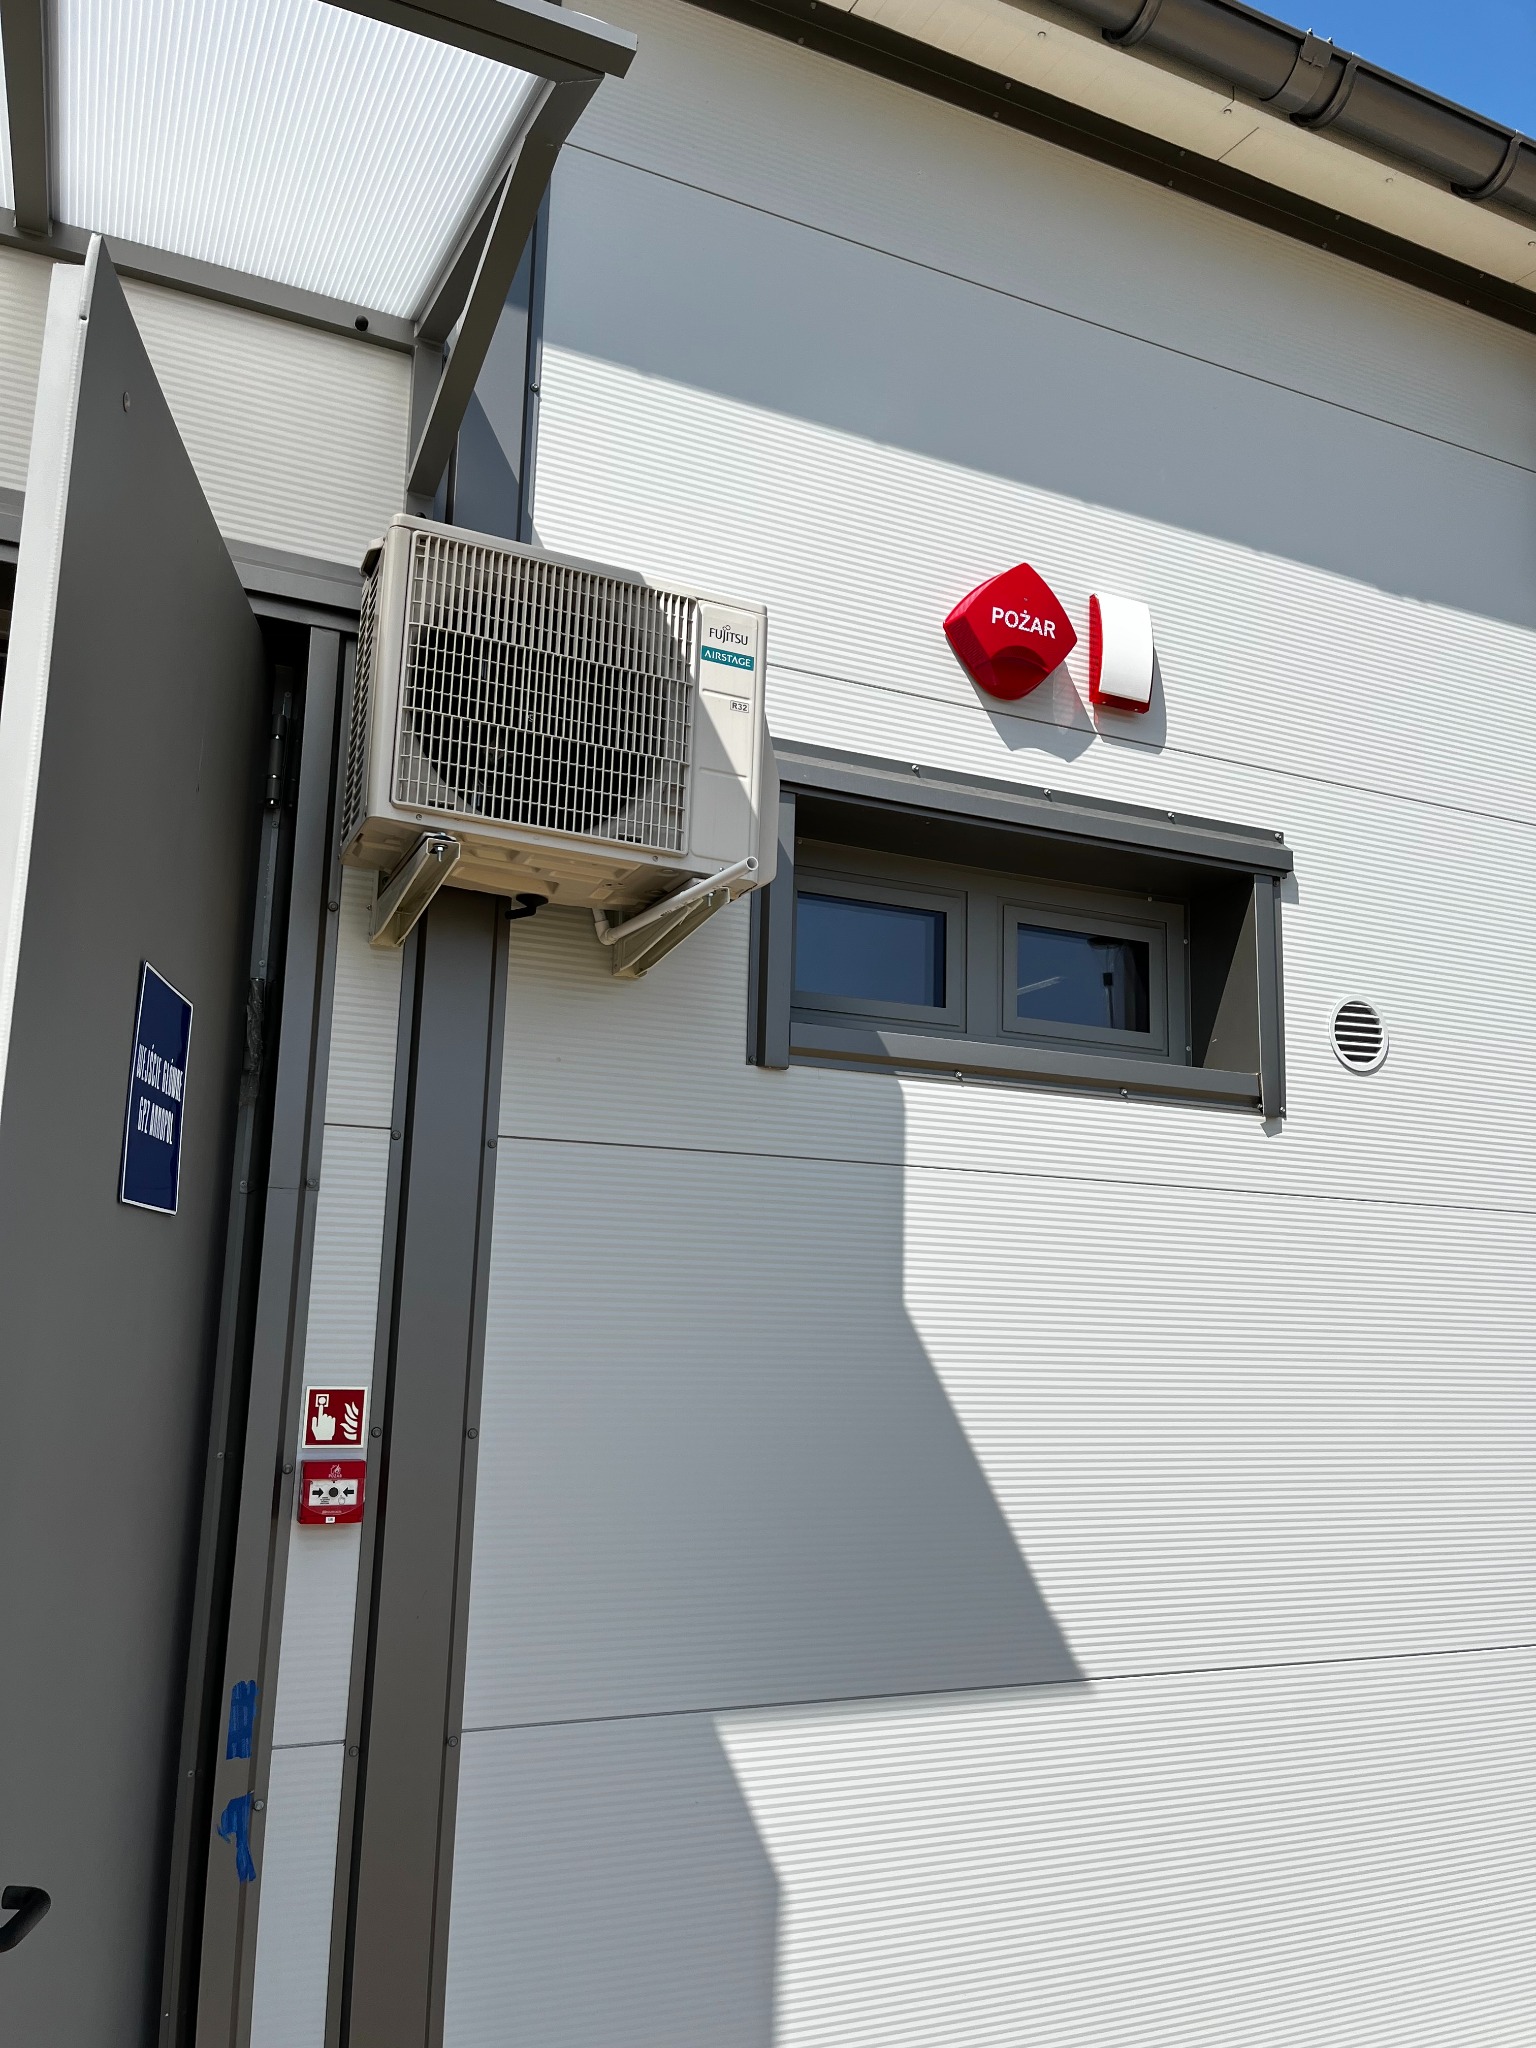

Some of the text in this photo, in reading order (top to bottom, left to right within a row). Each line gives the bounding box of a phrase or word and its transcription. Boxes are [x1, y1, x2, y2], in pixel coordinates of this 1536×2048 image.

[991, 606, 1056, 639] POŻAR
[709, 625, 748, 645] FUJITSU
[704, 650, 751, 667] AIRSTAGE
[732, 702, 748, 712] R32
